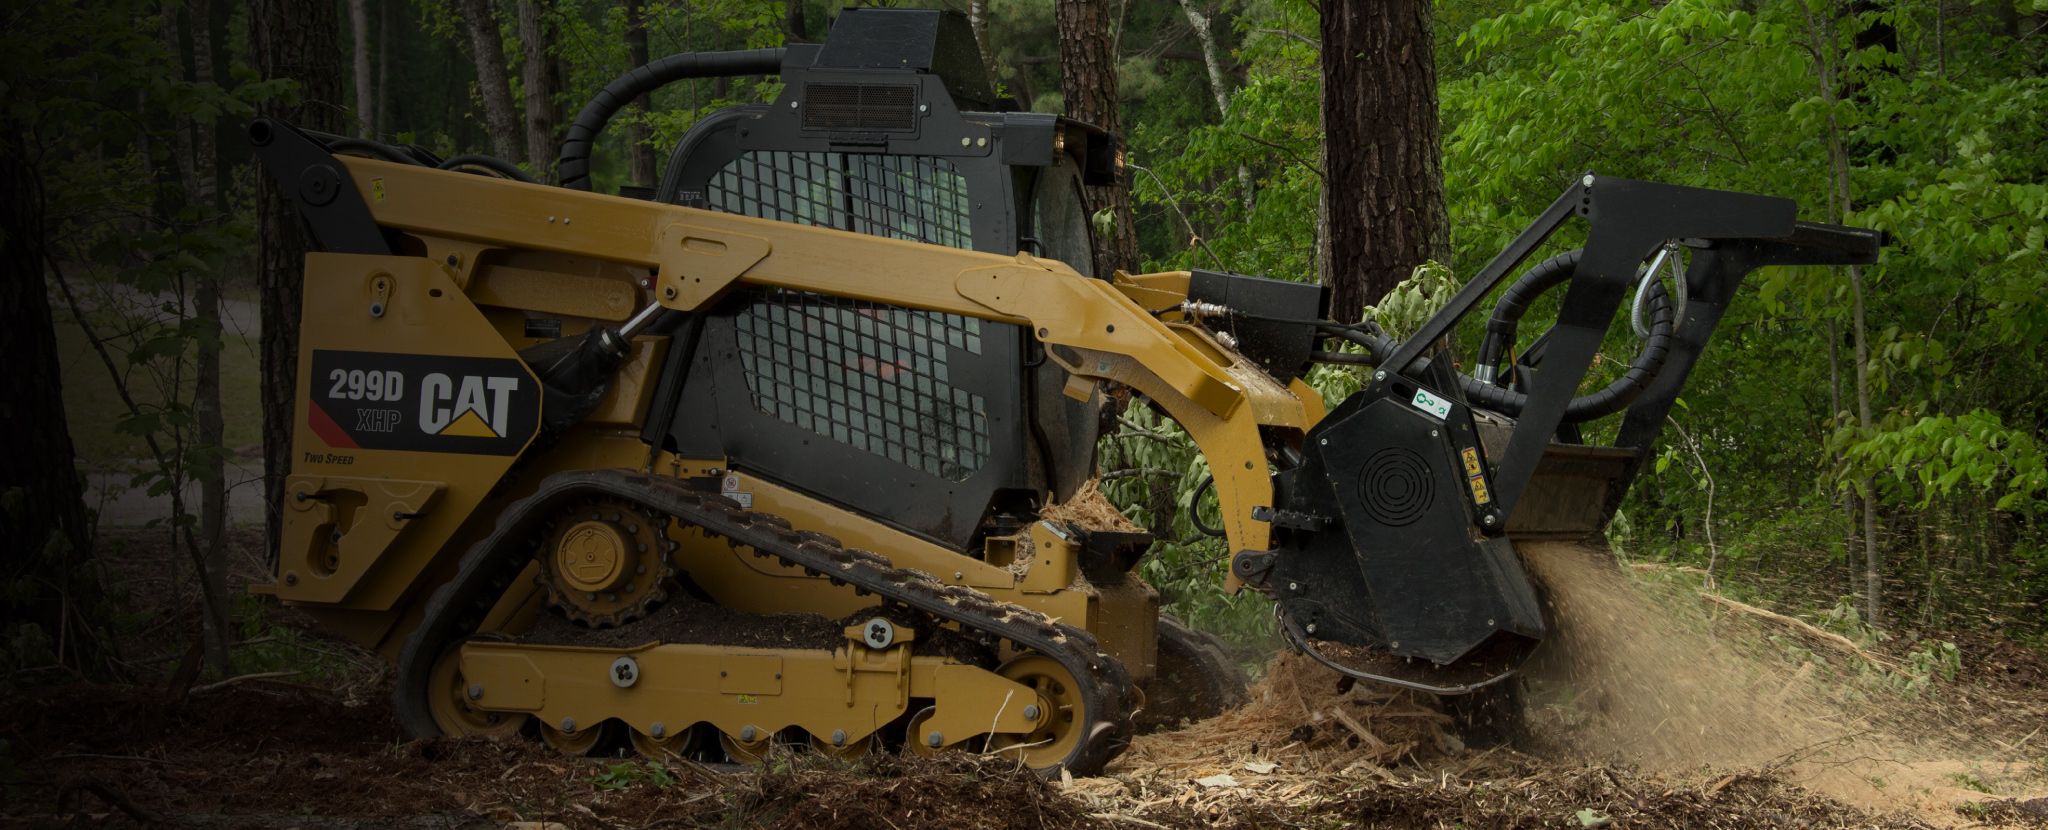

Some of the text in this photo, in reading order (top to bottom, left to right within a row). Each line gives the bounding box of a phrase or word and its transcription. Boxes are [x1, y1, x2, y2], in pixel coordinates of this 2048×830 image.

[329, 369, 404, 401] 299D
[356, 408, 402, 432] XHP
[418, 373, 519, 438] CAT
